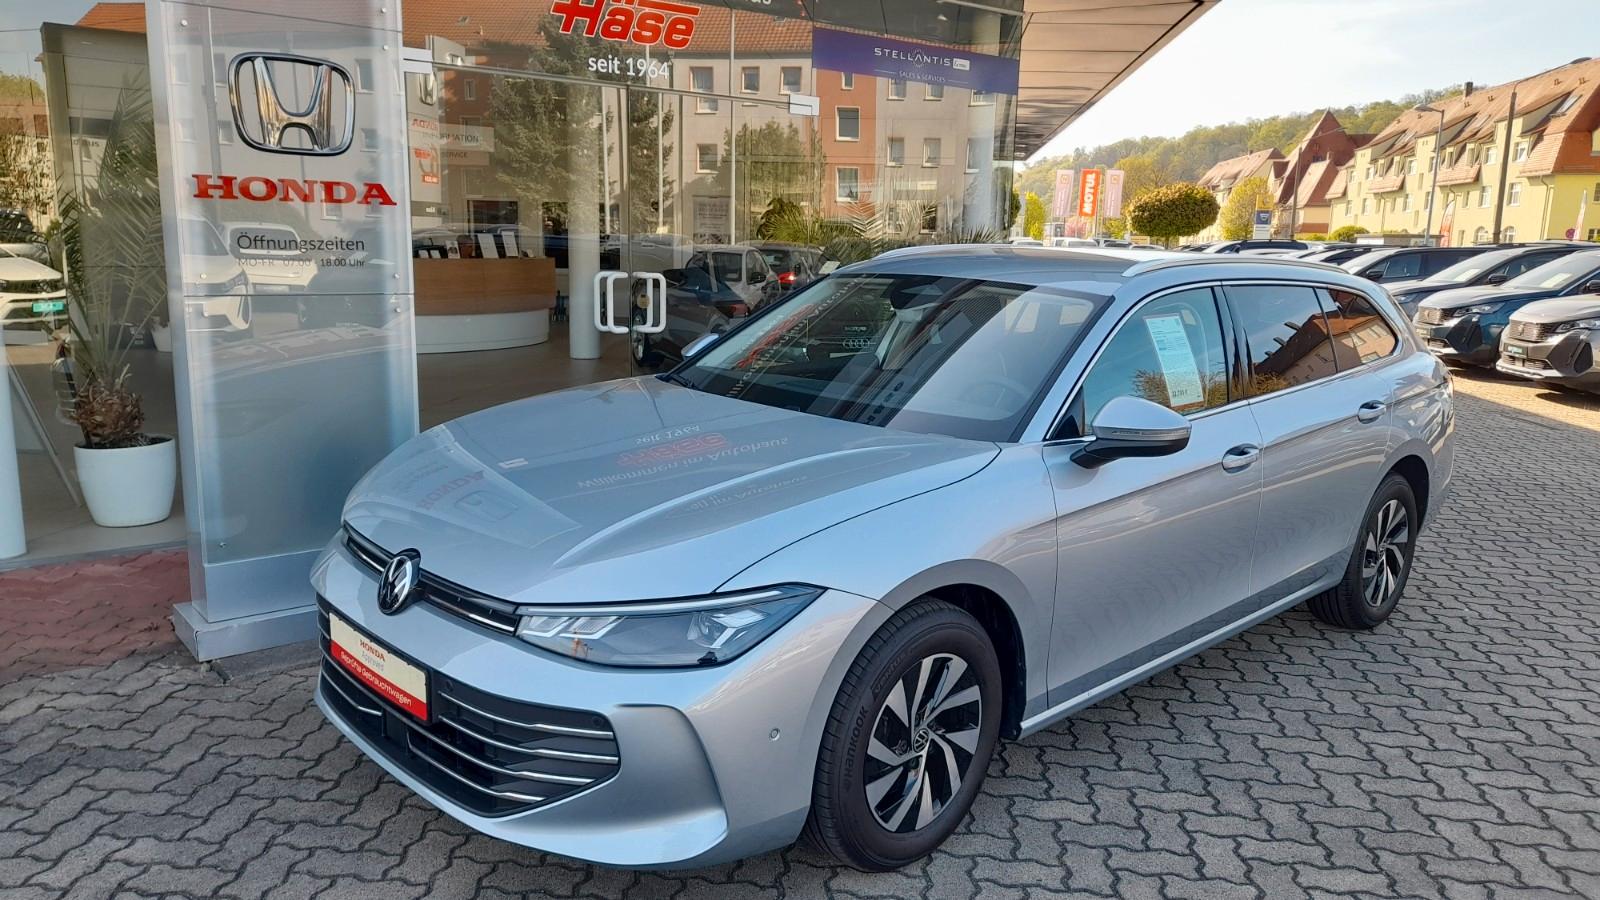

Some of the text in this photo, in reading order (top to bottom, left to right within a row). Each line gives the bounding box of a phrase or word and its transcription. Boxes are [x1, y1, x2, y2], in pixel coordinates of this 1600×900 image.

[588, 55, 670, 79] seit 1964
[874, 47, 951, 66] STELLANTIS
[192, 174, 397, 206] HONDA
[1082, 172, 1096, 214] MOTUL
[237, 232, 365, 253] Öffnungszeiten
[349, 259, 365, 267] Uhr
[360, 639, 385, 662] HONDA
